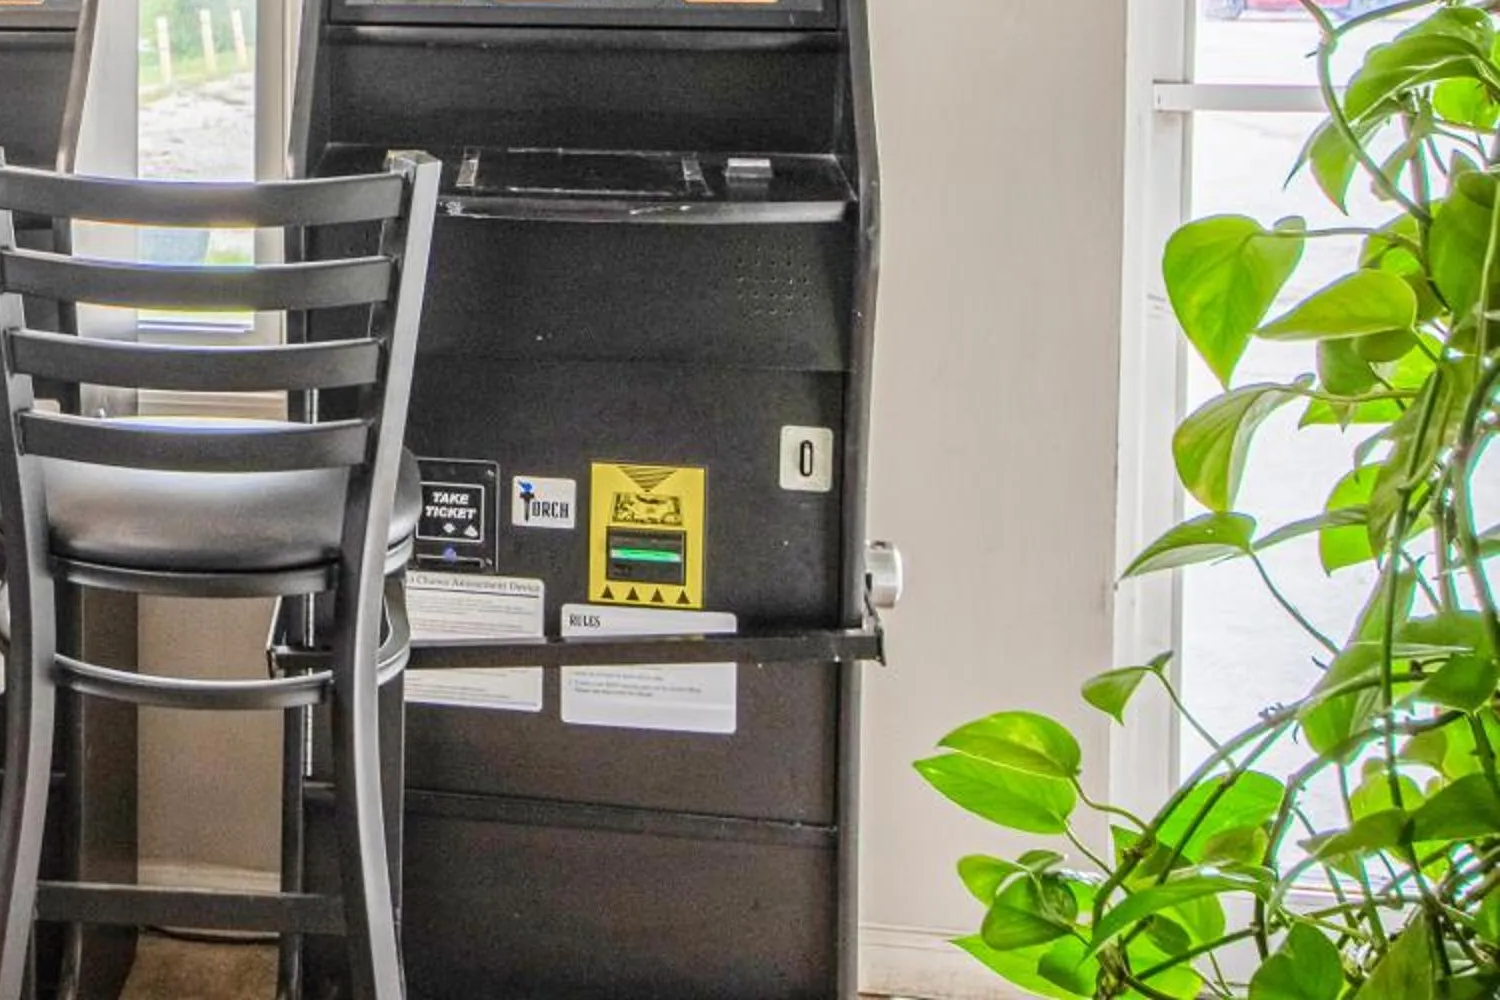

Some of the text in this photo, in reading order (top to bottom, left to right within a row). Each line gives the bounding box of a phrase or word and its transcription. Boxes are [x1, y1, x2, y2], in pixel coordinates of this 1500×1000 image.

[432, 491, 469, 505] TAKE
[425, 505, 477, 519] TICKET
[568, 613, 601, 628] RULES
